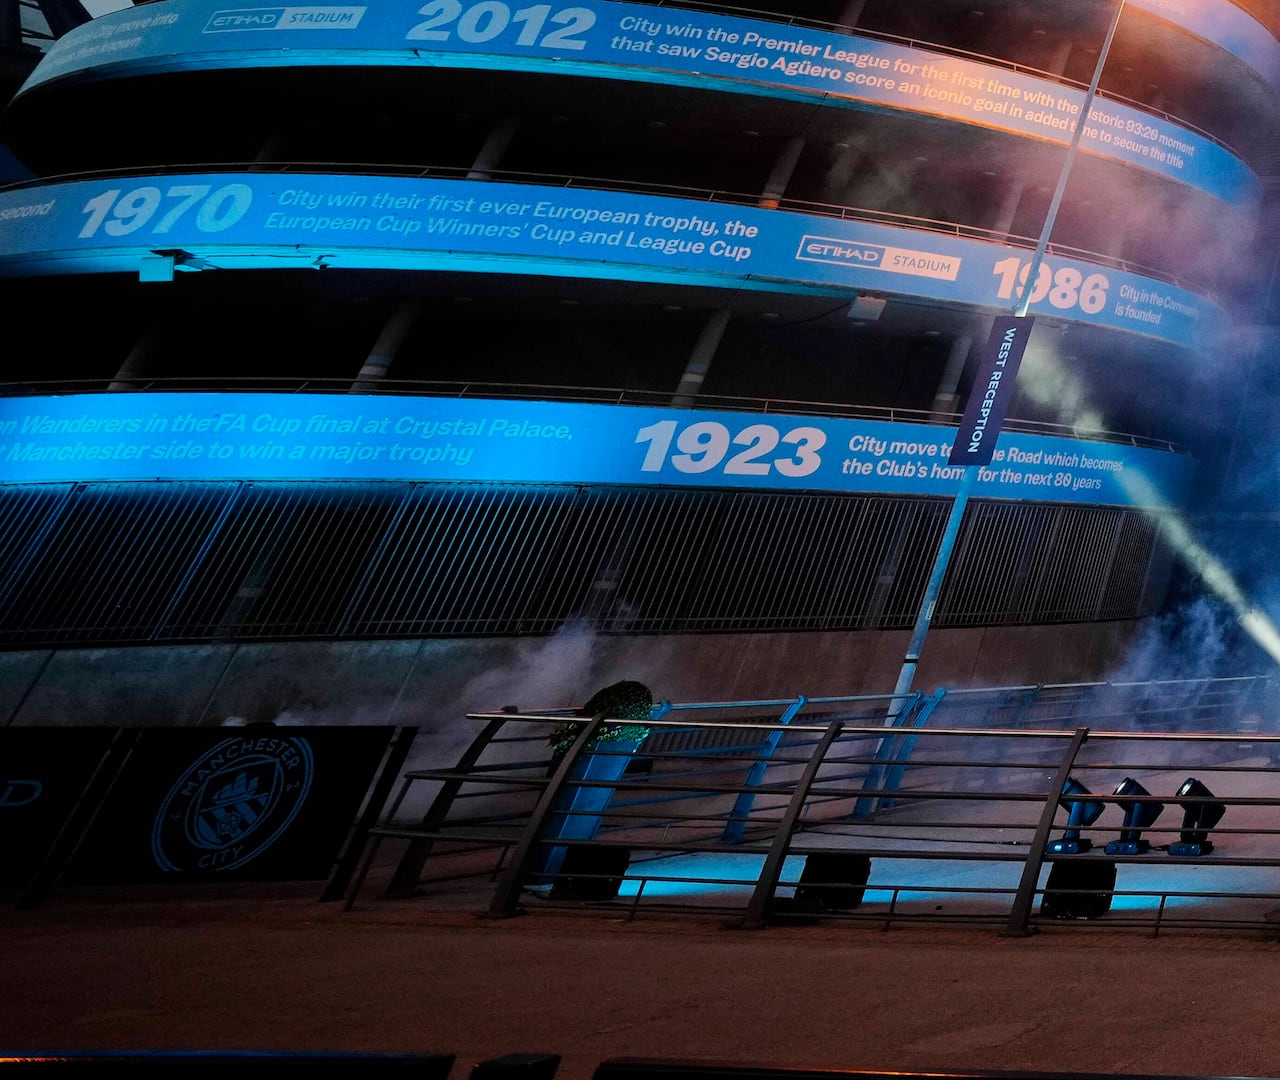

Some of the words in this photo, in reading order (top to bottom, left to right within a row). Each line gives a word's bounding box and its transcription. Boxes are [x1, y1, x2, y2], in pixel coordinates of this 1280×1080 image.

[213, 14, 275, 26] ETIHAD
[290, 12, 353, 24] STADIUM
[610, 35, 652, 53] that
[658, 43, 702, 58] saw
[704, 46, 769, 71] Sergio
[770, 56, 842, 80] Agüero
[844, 68, 896, 90] score
[898, 80, 920, 96] an
[922, 86, 972, 107] iconic
[972, 95, 1008, 116] goal
[1009, 103, 1023, 118] in
[1024, 109, 1068, 131] added
[620, 16, 662, 36] City
[666, 22, 702, 40] win
[706, 27, 740, 44] the
[743, 32, 822, 58] Premier
[824, 44, 890, 72] League
[894, 58, 920, 74] for
[920, 64, 950, 83] the
[952, 70, 986, 91] first
[986, 80, 1022, 100] time
[1024, 90, 1054, 108] with
[1057, 97, 1078, 116] the
[78, 184, 252, 238] 1970
[278, 190, 322, 211] City
[328, 193, 366, 207] win
[372, 193, 423, 213] their
[426, 194, 474, 215] first
[478, 201, 530, 218] ever
[532, 202, 640, 226] European
[644, 212, 719, 238] trophy,
[724, 221, 758, 238] the
[264, 212, 370, 233] European
[376, 216, 422, 237] Cup
[530, 224, 575, 245] Cup
[578, 229, 623, 246] and
[624, 232, 706, 256] League
[709, 240, 752, 262] Cup
[806, 244, 880, 262] ETIHAD
[892, 255, 952, 274] STADIUM
[996, 328, 1016, 368] WEST
[20, 414, 141, 434] Wanderers
[252, 414, 300, 437] Cup
[304, 416, 364, 434] final
[364, 417, 391, 435] at
[394, 416, 487, 439] Crystal
[968, 371, 1002, 452] RECEPTION
[150, 440, 202, 460] side
[208, 442, 236, 460] to
[240, 440, 285, 460] win
[310, 442, 389, 464] major
[388, 444, 475, 466] trophy
[634, 420, 828, 478] 1923
[848, 435, 888, 456] City
[889, 444, 938, 460] move
[1006, 447, 1041, 465] Road
[1044, 450, 1078, 469] which
[842, 459, 872, 476] the
[876, 459, 928, 479] Club's
[1000, 467, 1022, 483] the
[1024, 471, 1053, 487] next
[181, 738, 300, 798] MANCHESTER
[198, 844, 244, 869] CITY
